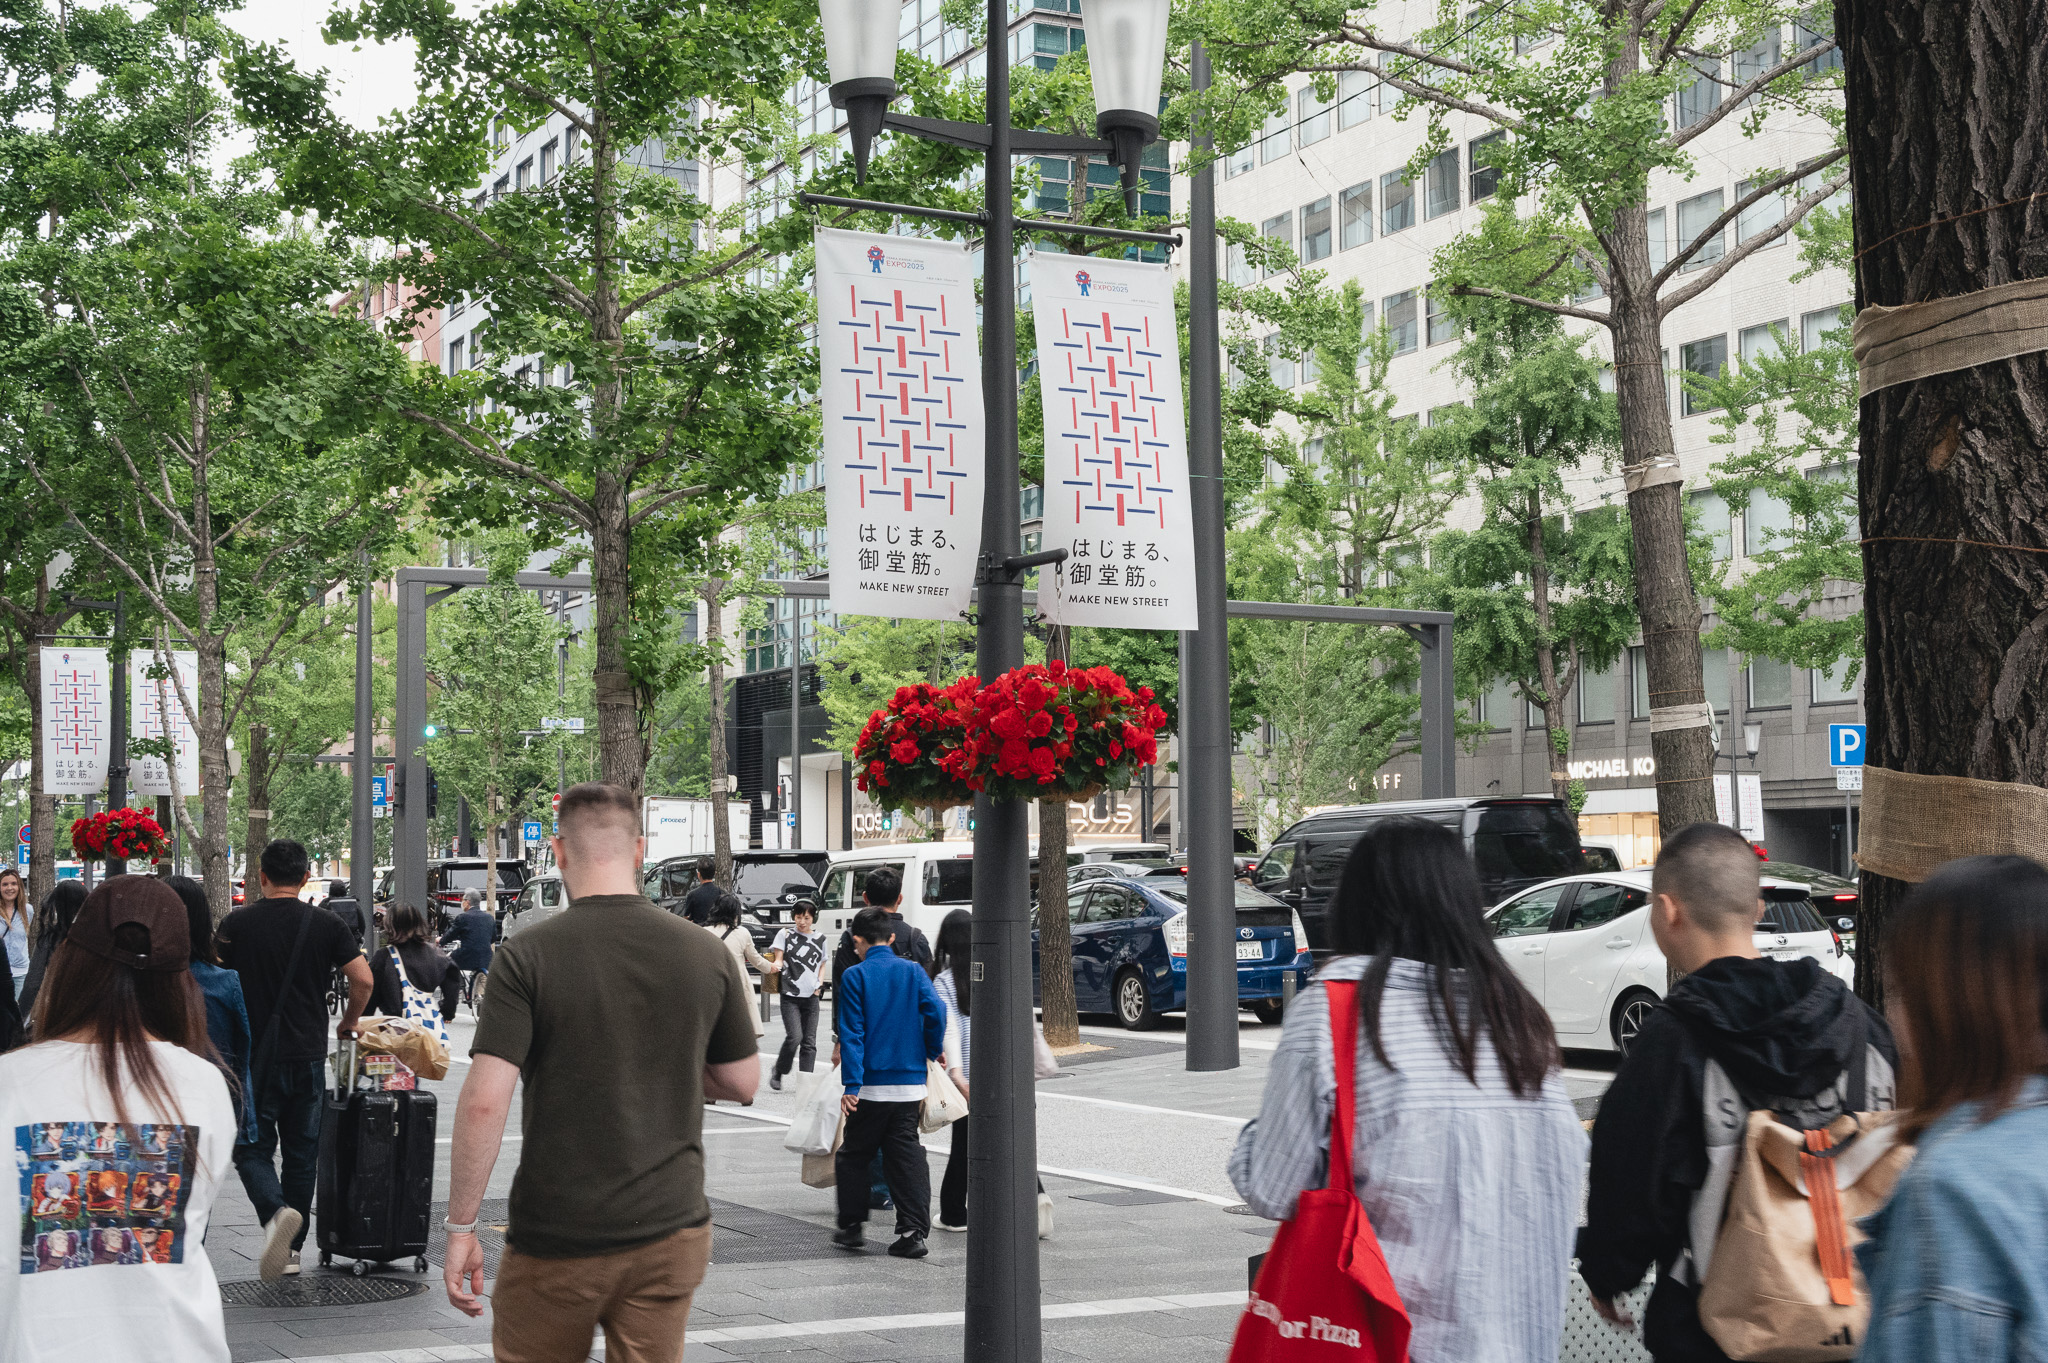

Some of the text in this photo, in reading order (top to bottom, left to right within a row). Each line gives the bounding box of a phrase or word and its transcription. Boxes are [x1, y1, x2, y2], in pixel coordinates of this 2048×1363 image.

[859, 523, 955, 550] はじまる、
[1072, 538, 1169, 562] はじまる、
[858, 547, 941, 576] 御堂筋。
[1069, 562, 1157, 588] 御堂筋。
[859, 580, 950, 597] MAKE NEW STREET
[1068, 594, 1169, 607] MAKE NEW STREET
[1839, 728, 1860, 762] P
[55, 769, 92, 779] 御堂筋。
[56, 760, 98, 769] はじまる、
[143, 761, 187, 770] はじる、
[1567, 757, 1655, 779] MICHAEL KO
[1348, 773, 1402, 792] GAFF
[1069, 803, 1133, 827] QOS
[526, 825, 540, 838] 停
[1309, 1315, 1362, 1349] Pizza
